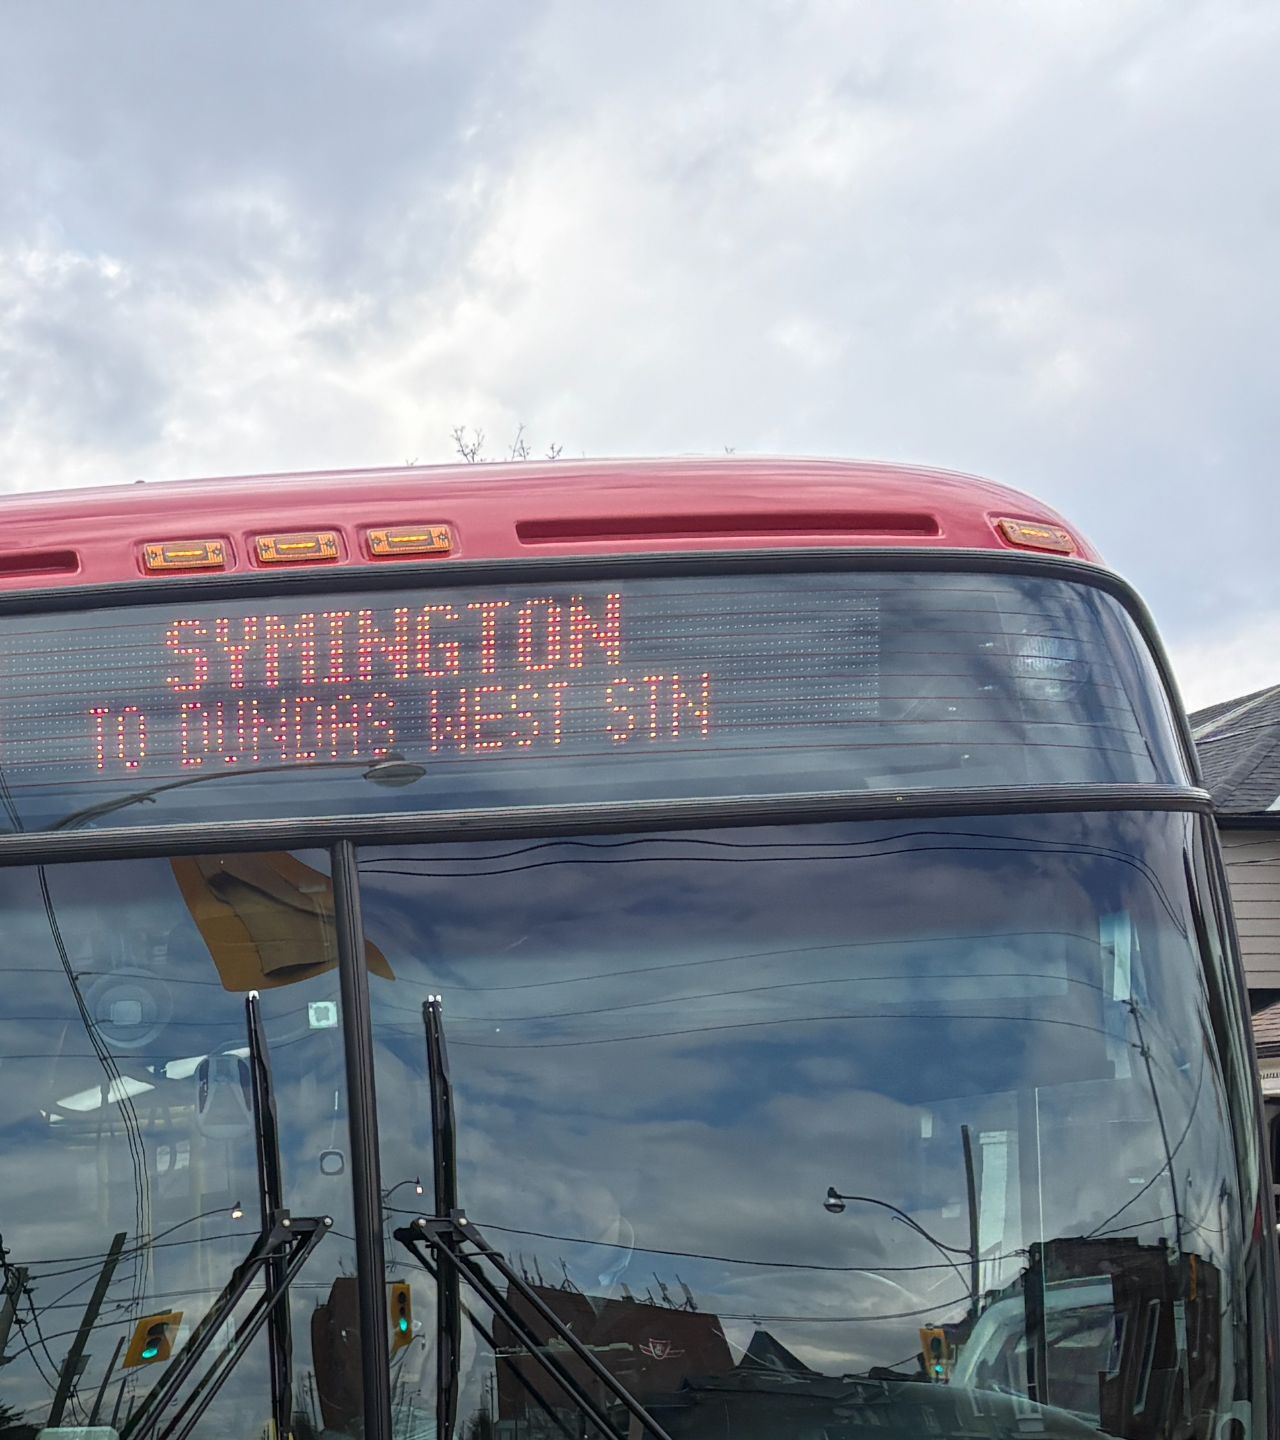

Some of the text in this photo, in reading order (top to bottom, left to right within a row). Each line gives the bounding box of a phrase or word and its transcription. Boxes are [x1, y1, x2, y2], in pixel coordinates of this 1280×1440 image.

[164, 592, 623, 692] SYMINGTON
[89, 672, 713, 769] TO DUNDAS WEST STN
